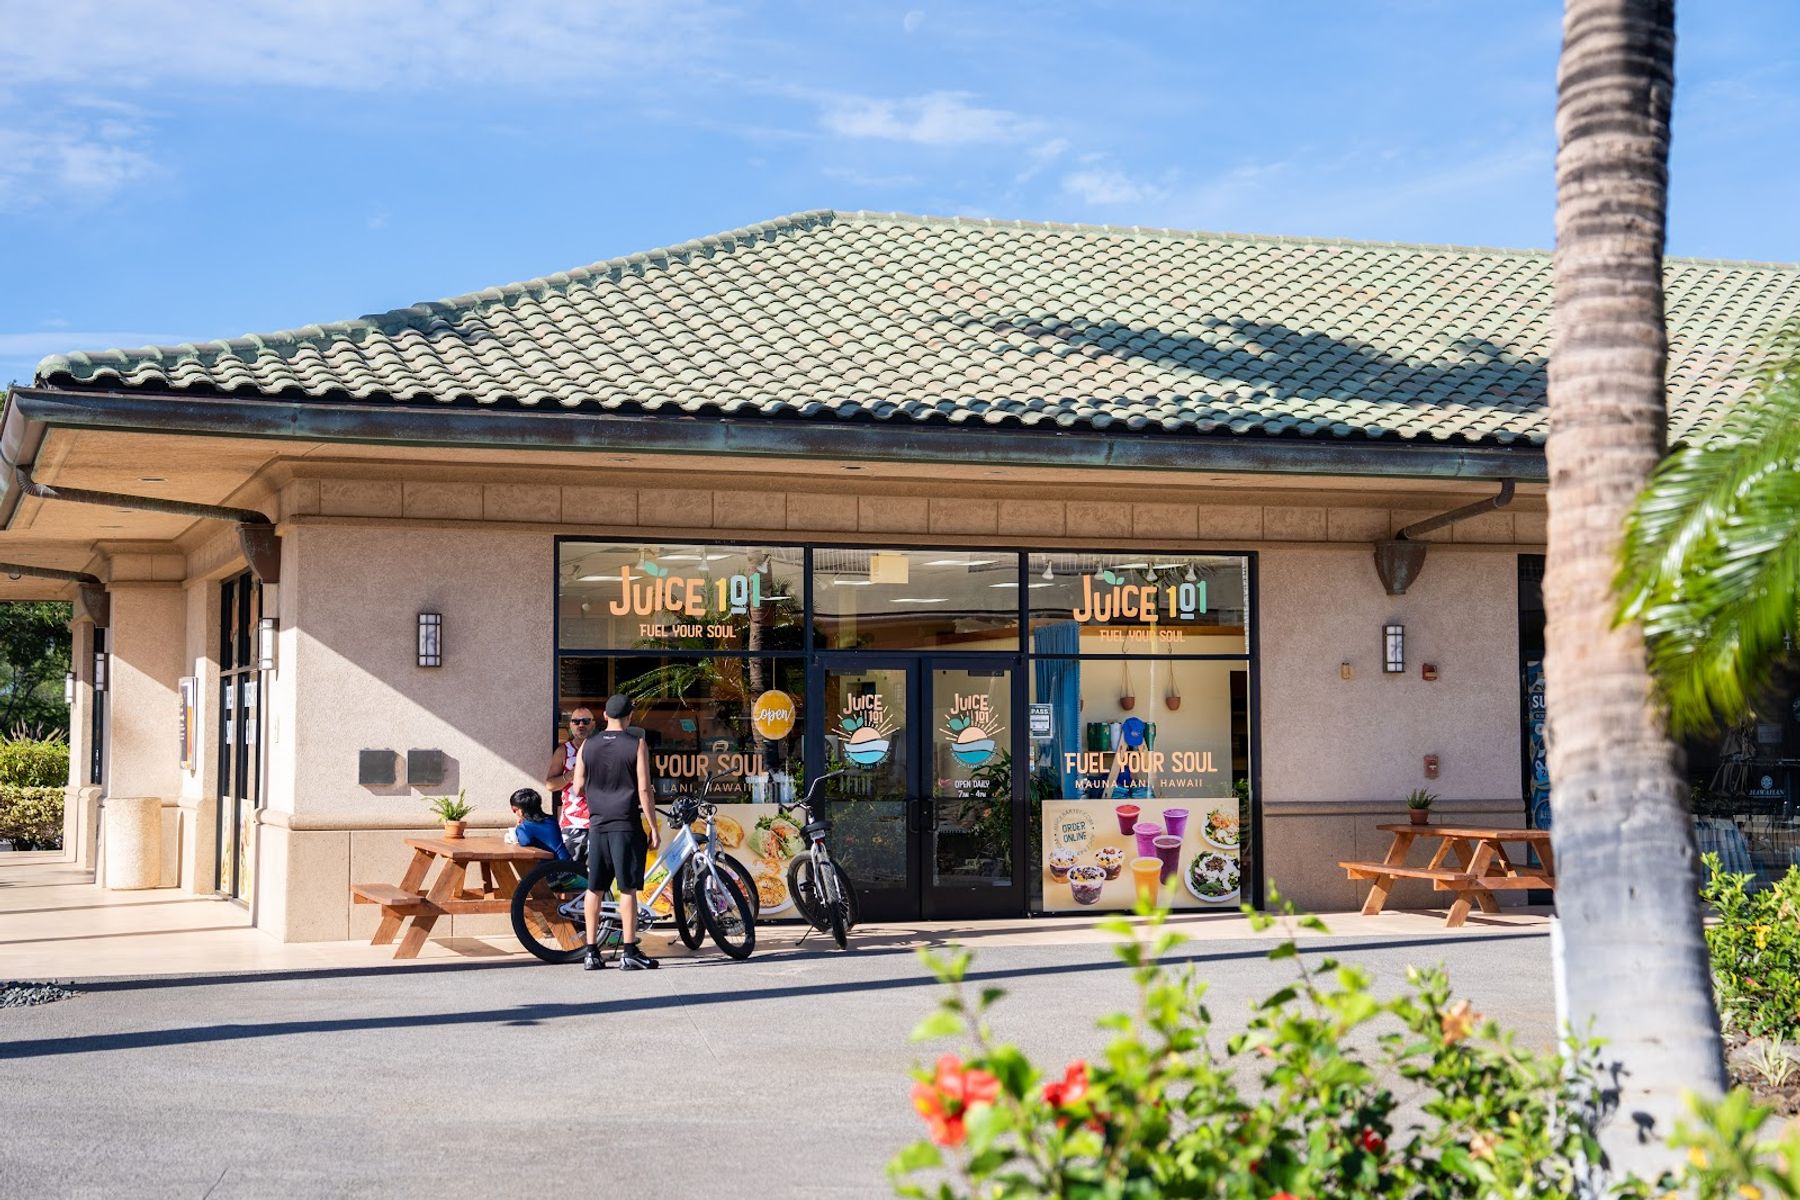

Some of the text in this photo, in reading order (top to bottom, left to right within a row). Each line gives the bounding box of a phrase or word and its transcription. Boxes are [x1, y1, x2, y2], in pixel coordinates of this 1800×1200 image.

[609, 565, 762, 617] JUICE 101
[1073, 574, 1208, 622] JUICE 101
[639, 624, 737, 638] FUEL YOUR SOUL
[1099, 629, 1186, 643] FUEL YOUR SOUL
[842, 692, 883, 715] JUICE
[950, 692, 989, 715] JUICE
[753, 704, 795, 727] open
[868, 710, 883, 724] 101
[974, 710, 989, 724] 101
[655, 754, 769, 778] YOUR SOUL
[1064, 751, 1218, 774] FUEL YOUR SOUL
[954, 780, 991, 789] OPEN DAILY
[1075, 779, 1118, 789] MAUNA
[1160, 778, 1203, 788] HAWAII
[1061, 821, 1086, 833] ORDER
[1063, 831, 1087, 843] ONLINE
